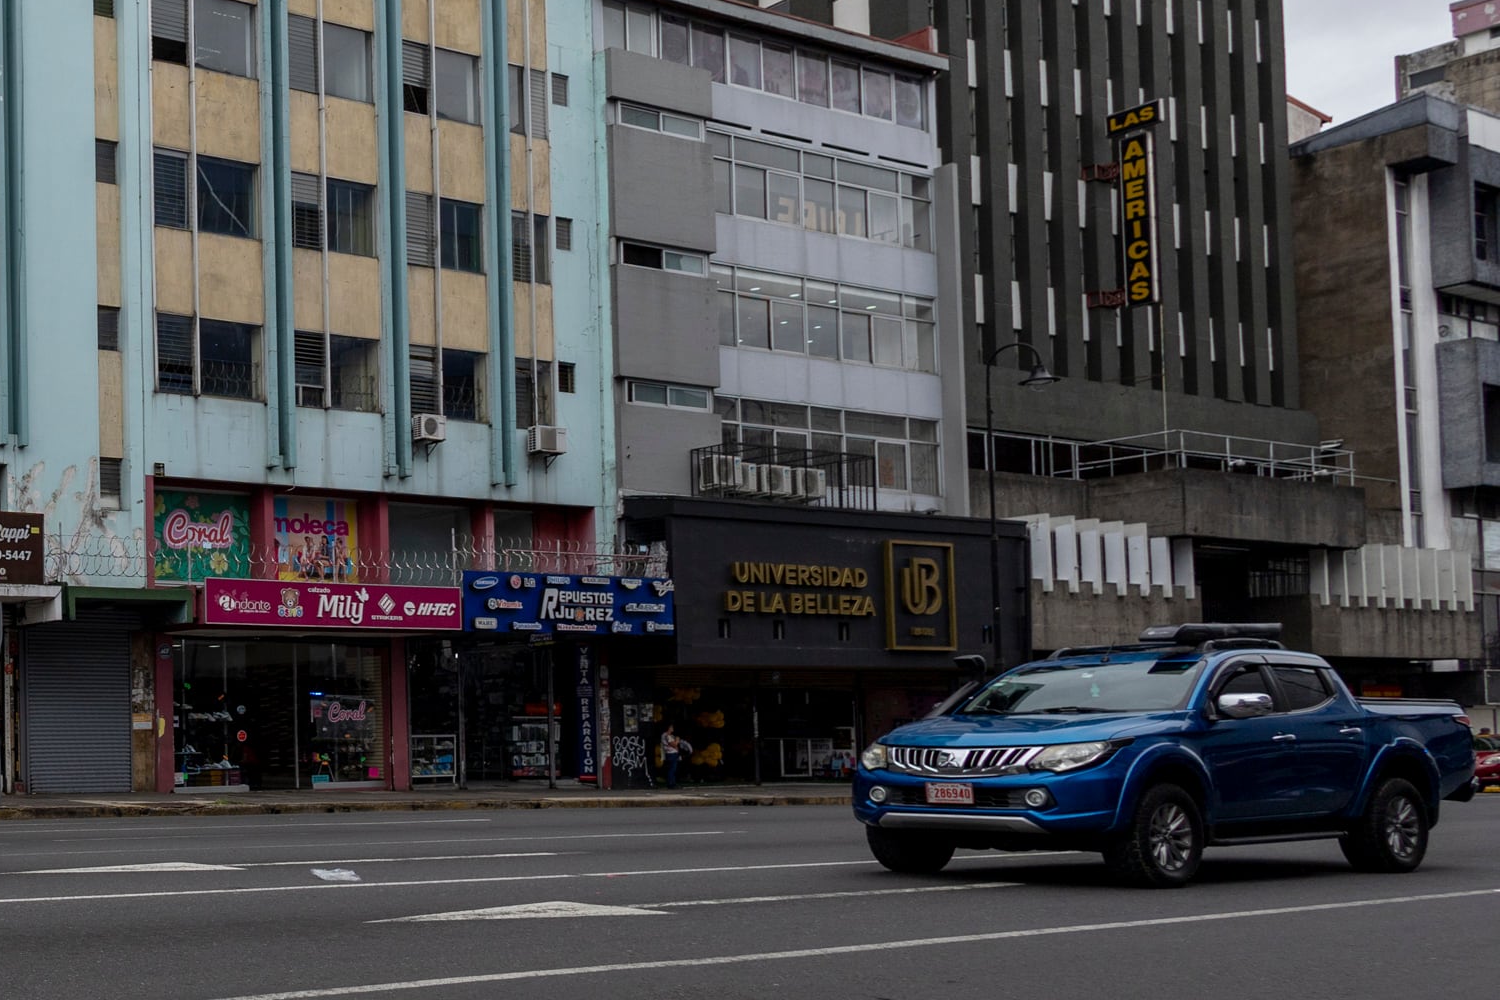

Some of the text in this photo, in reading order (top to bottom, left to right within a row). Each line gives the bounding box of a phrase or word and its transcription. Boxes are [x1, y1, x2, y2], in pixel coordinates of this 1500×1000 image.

[1109, 106, 1155, 132] LAS
[1122, 140, 1150, 301] AMERICAS
[168, 513, 231, 545] Coral
[274, 513, 349, 536] moleca
[523, 577, 536, 588] LG
[731, 561, 868, 589] UNIVERSIDAD
[317, 594, 364, 624] Mily
[417, 602, 456, 616] HI-TEC
[540, 588, 614, 619] REPUESTOS
[726, 590, 878, 617] DE LA BELLEZA
[579, 646, 589, 685] VENTA
[328, 701, 367, 723] Coral
[579, 697, 594, 774] REPARACIÓN
